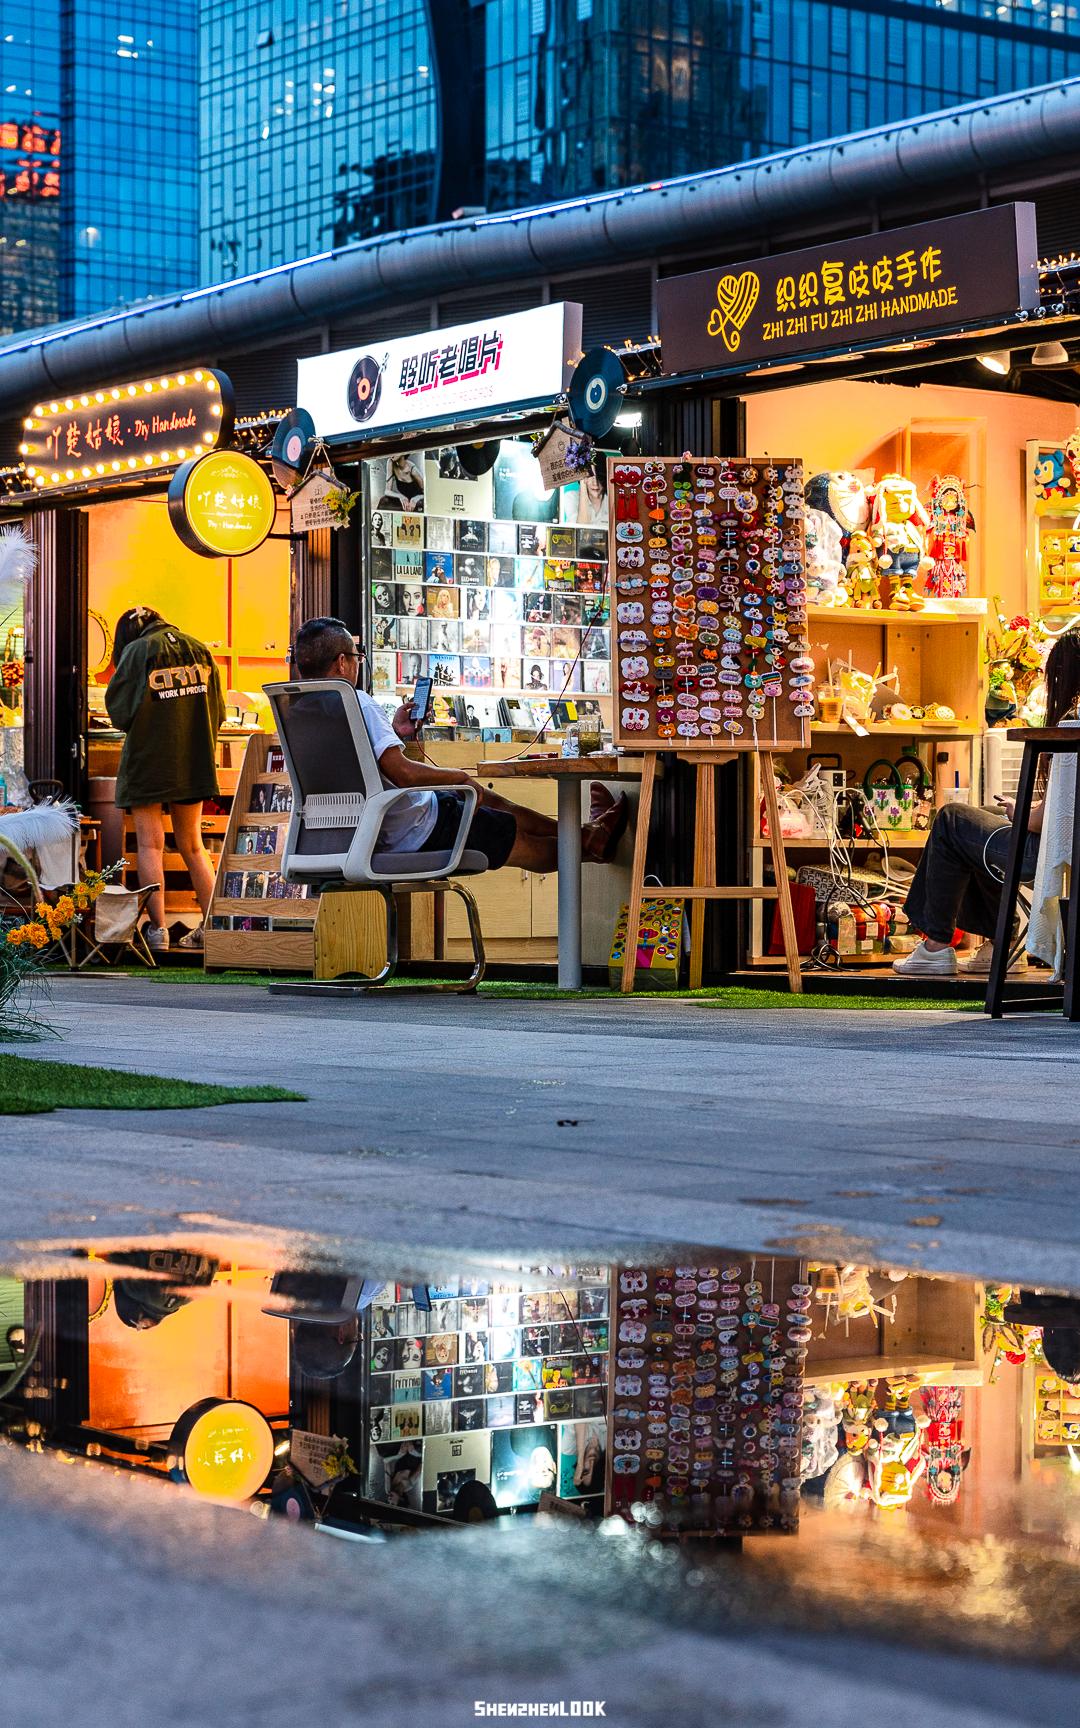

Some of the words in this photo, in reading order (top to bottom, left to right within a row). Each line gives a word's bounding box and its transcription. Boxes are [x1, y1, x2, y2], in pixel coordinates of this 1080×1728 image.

[776, 246, 942, 312] 织织复吱吱手作
[763, 320, 784, 341] ZHI
[787, 316, 808, 337] ZHI
[811, 312, 828, 332] FU
[831, 309, 852, 329] ZHI
[855, 304, 879, 324] ZHI
[881, 286, 958, 318] HANDMADE
[398, 330, 504, 396] 聆听老唱片
[152, 408, 197, 434] Handmade
[396, 523, 421, 538] 1989
[158, 689, 179, 700] WORK
[179, 687, 186, 697] IN
